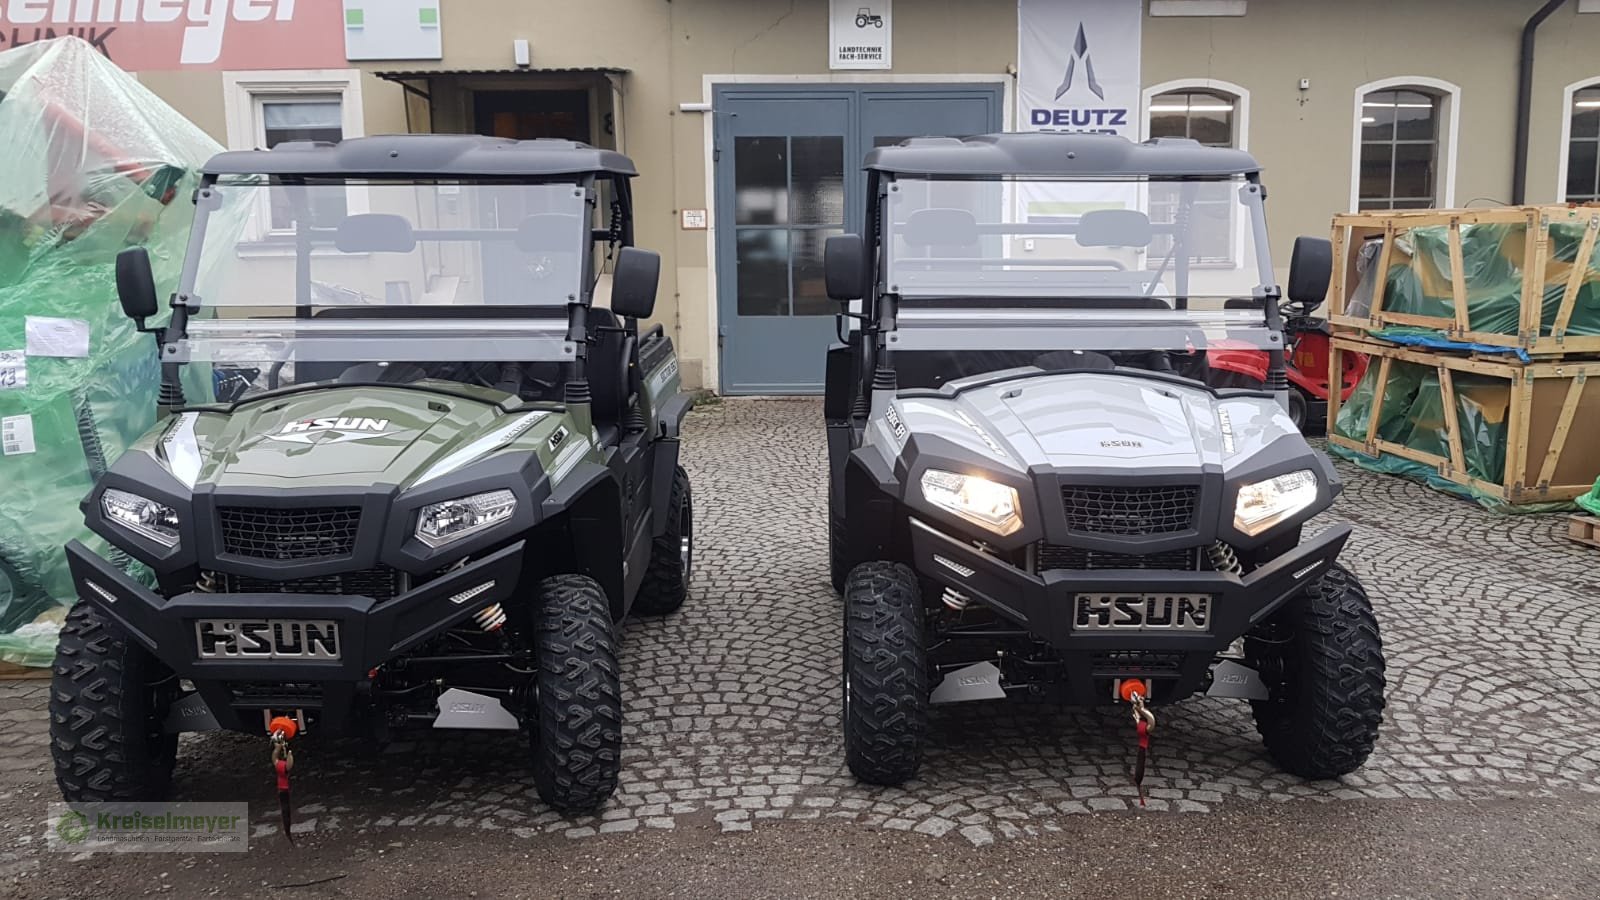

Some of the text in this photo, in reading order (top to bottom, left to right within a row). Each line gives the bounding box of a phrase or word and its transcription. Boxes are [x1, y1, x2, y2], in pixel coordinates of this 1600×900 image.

[1031, 109, 1127, 126] DEUTZ
[279, 416, 391, 434] HSUN
[550, 427, 565, 448] HSUN
[1076, 596, 1208, 628] HSUN
[200, 622, 338, 656] HSUN
